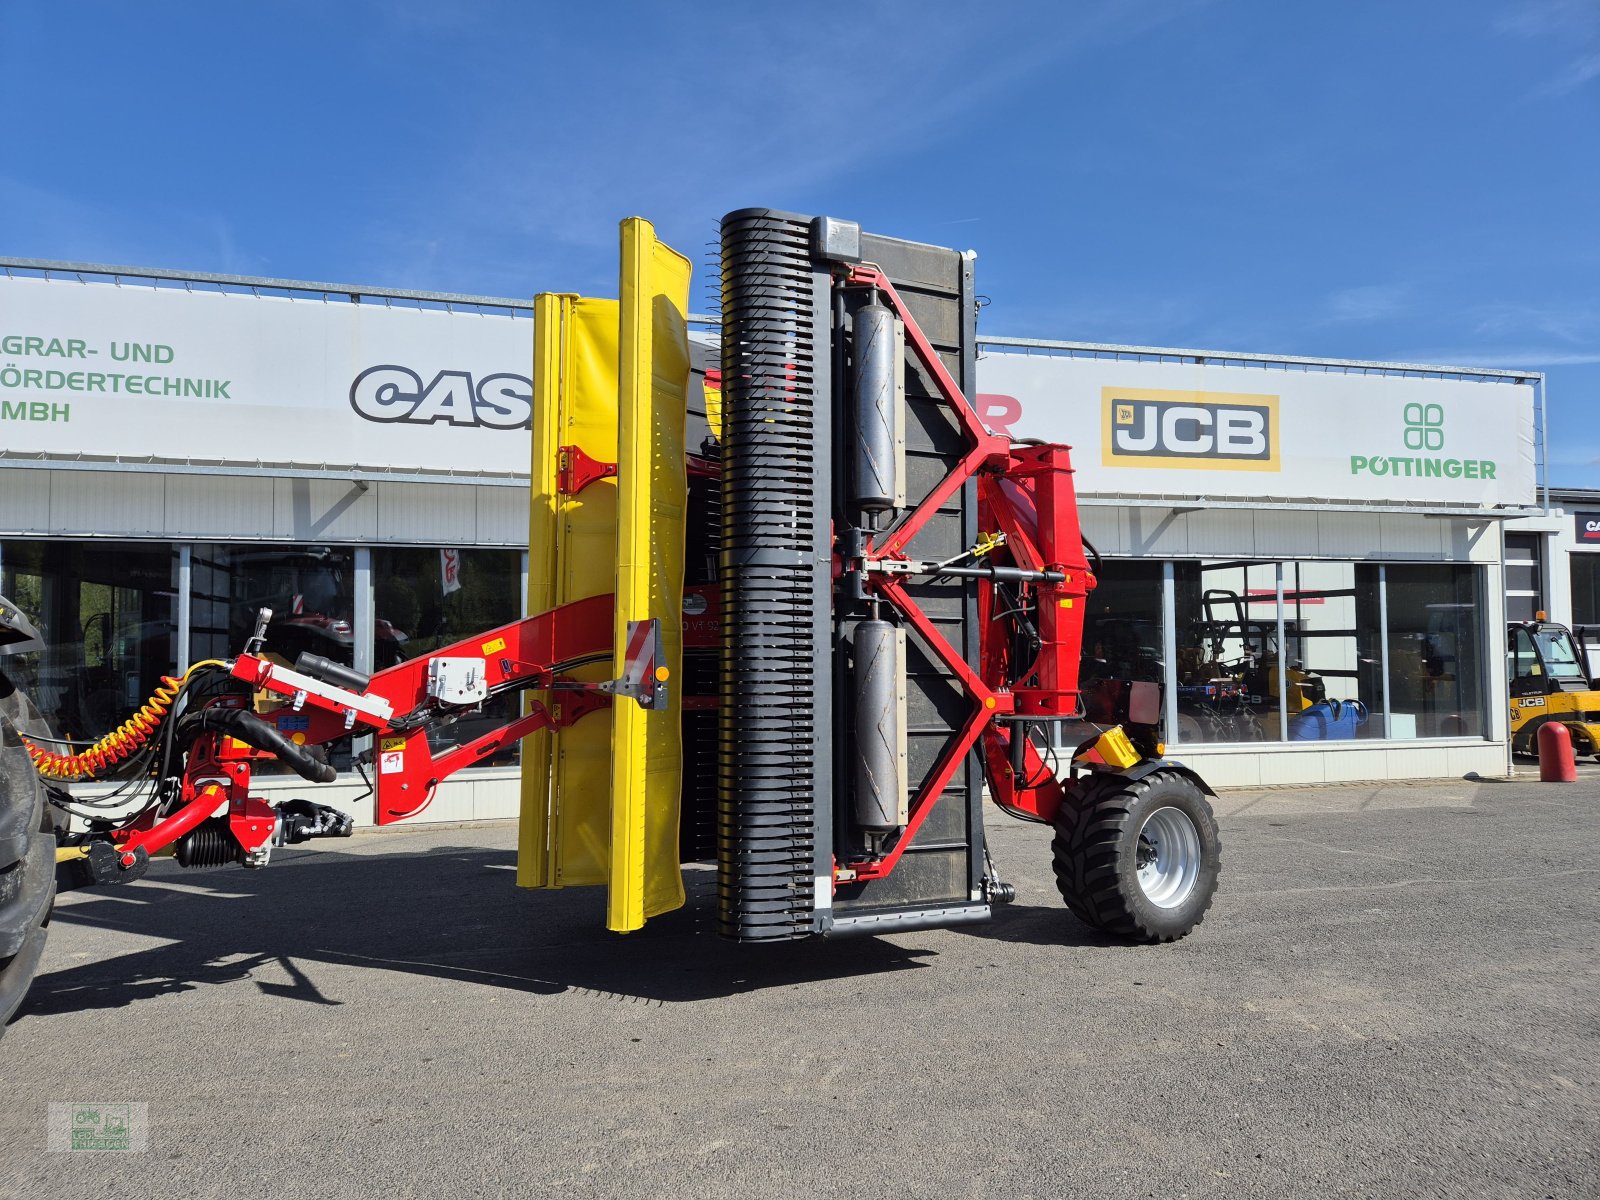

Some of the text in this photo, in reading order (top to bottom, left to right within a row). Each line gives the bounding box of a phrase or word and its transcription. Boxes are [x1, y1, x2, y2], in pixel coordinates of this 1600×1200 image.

[0, 335, 175, 364] GRAR- UND
[0, 363, 232, 399] ÖRDERTECHNIK
[349, 364, 532, 431] CAS
[1, 400, 70, 422] MBH
[1116, 405, 1266, 455] JCB
[1350, 455, 1496, 480] PÖTTINGER
[1240, 694, 1262, 704] CB
[1518, 697, 1545, 707] JCB
[1510, 708, 1521, 722] CB
